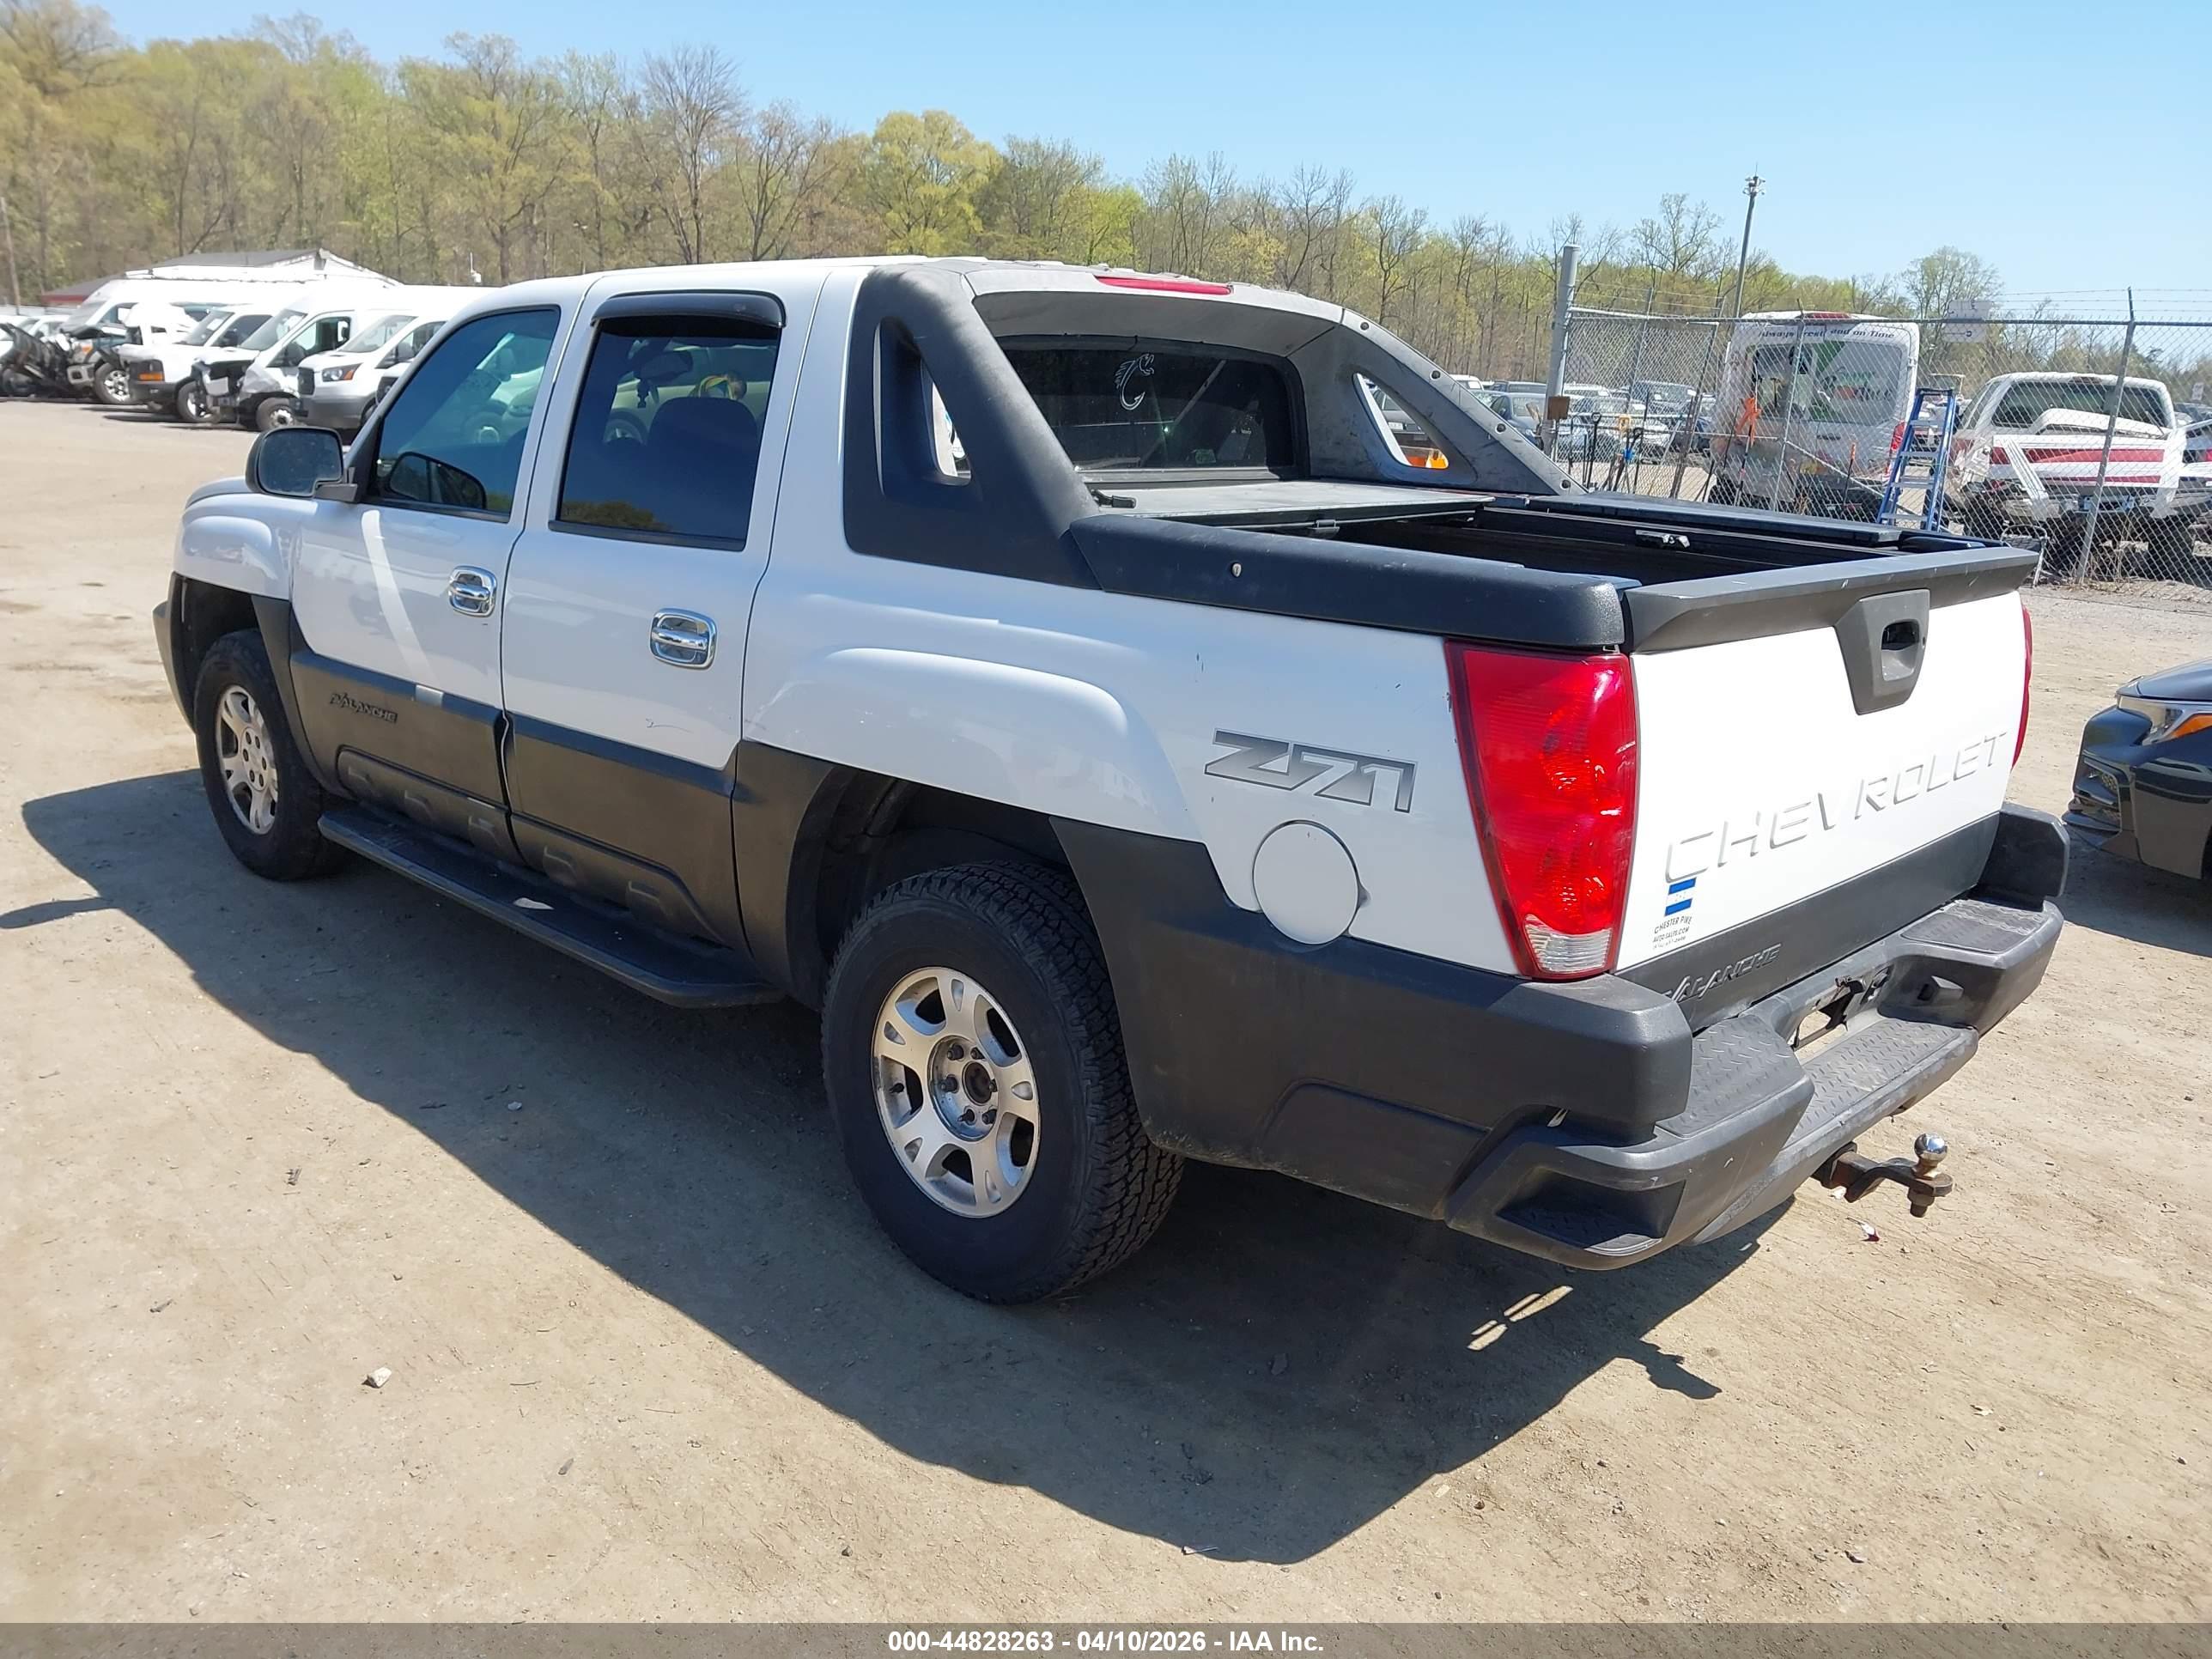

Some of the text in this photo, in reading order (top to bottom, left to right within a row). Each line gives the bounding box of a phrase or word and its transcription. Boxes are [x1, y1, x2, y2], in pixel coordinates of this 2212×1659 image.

[1203, 727, 1418, 814] Z71
[1664, 732, 2008, 884] CHEVROLET
[1654, 917, 1680, 933] CHESTER
